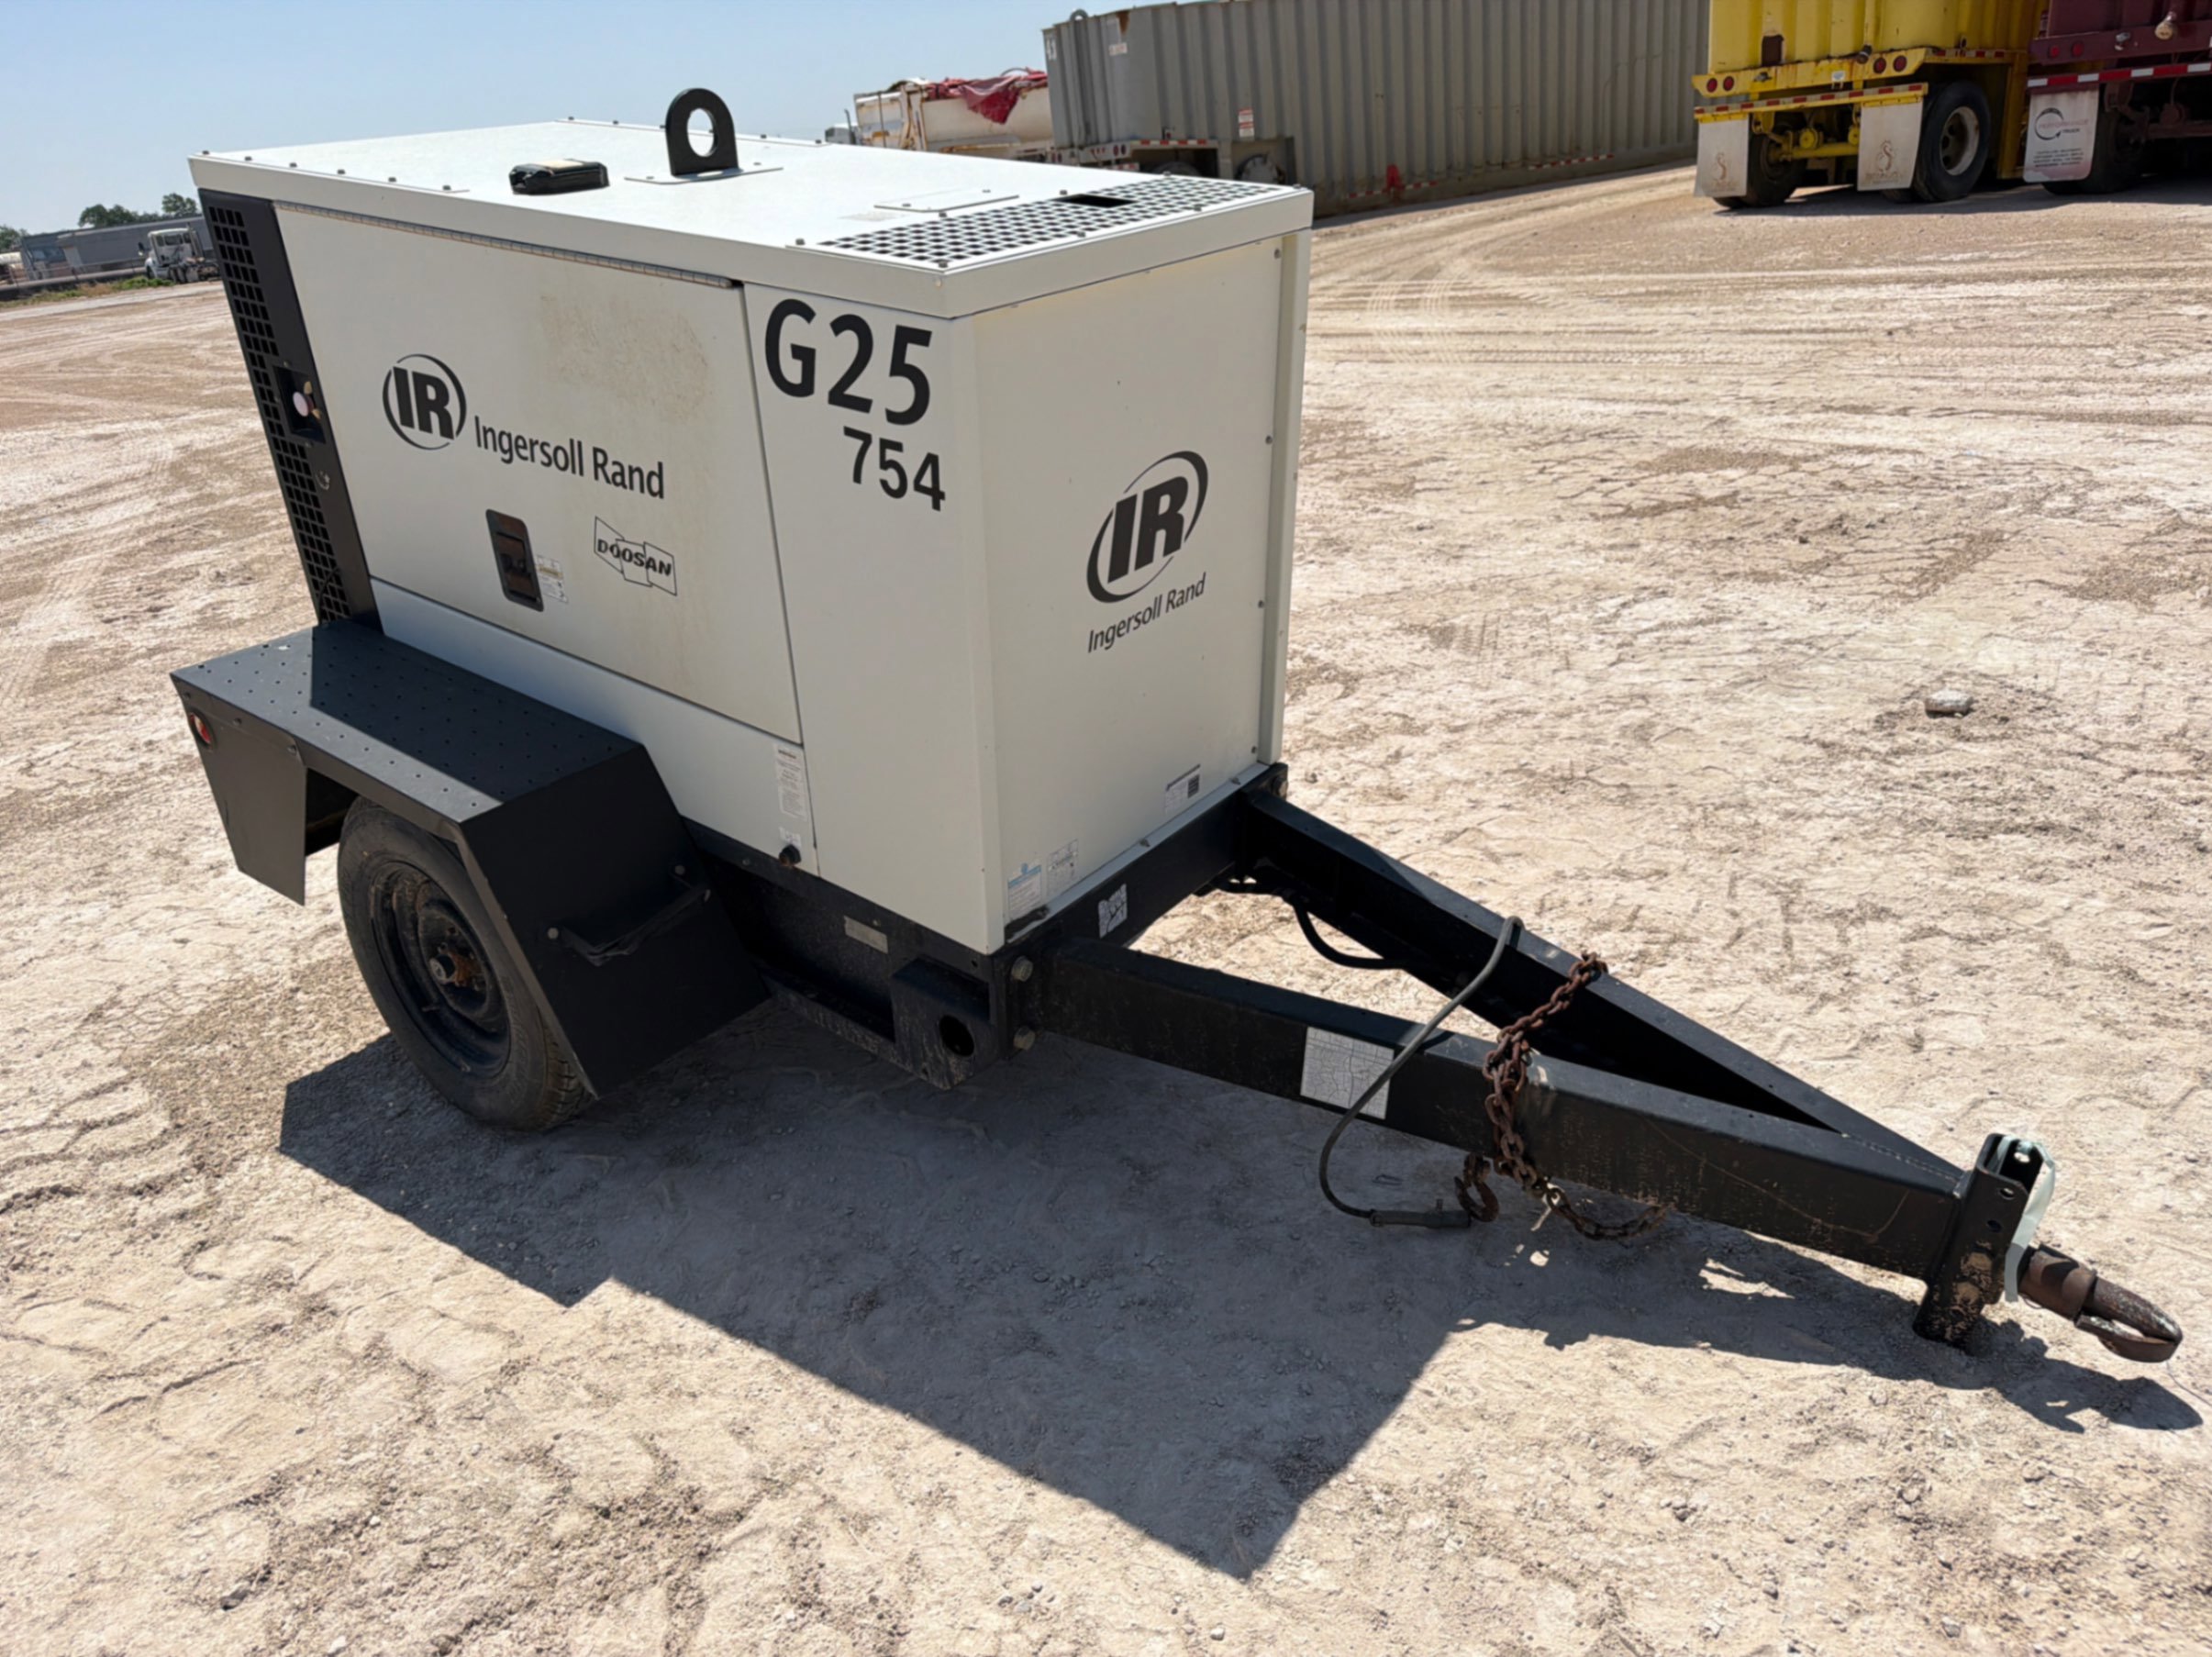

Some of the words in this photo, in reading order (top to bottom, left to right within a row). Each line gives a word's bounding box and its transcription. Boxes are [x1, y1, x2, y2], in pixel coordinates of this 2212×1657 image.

[393, 366, 454, 440] IR
[764, 298, 933, 426] G25
[474, 415, 584, 477] Ingersoll
[592, 446, 664, 499] Rand
[843, 426, 946, 512] 754
[597, 539, 672, 576] DOOSAN
[1106, 475, 1189, 584] IR
[1087, 594, 1163, 653] Ingersoll
[1165, 571, 1206, 614] Rand
